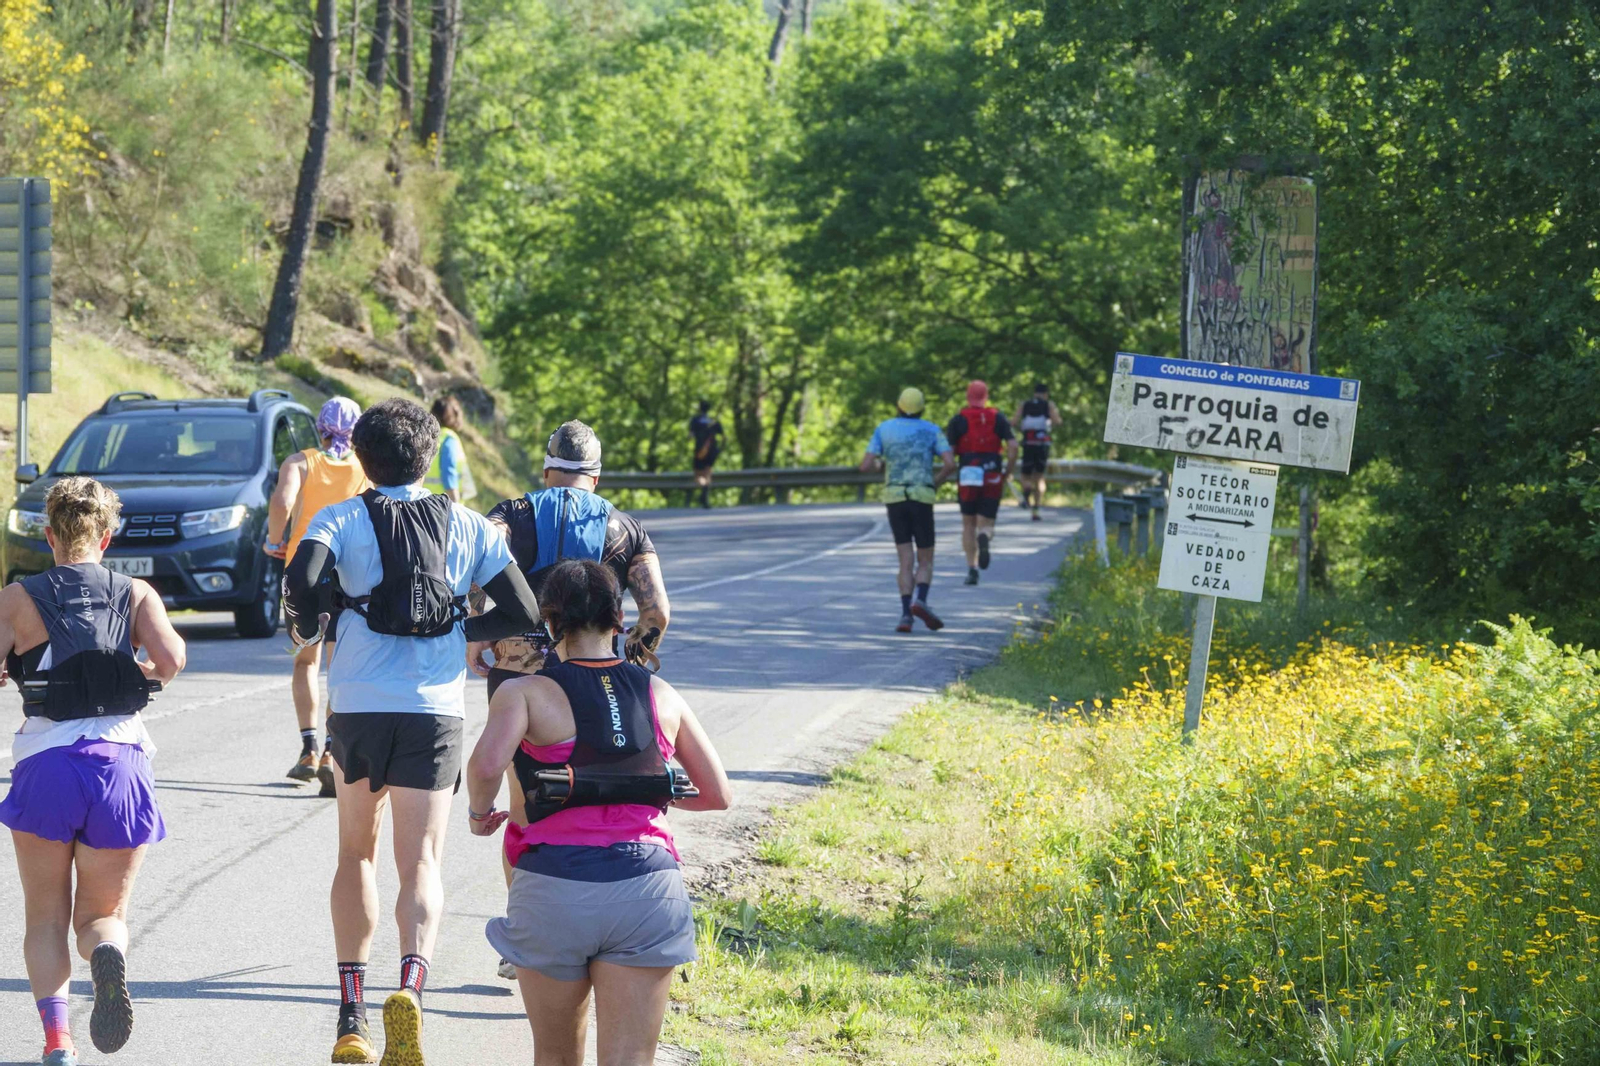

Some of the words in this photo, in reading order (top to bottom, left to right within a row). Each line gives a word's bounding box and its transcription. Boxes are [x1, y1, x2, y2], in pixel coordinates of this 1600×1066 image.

[1160, 364, 1218, 380] CONCELLO
[1220, 371, 1234, 382] de
[1237, 373, 1310, 391] PONTEAREAS
[1132, 382, 1278, 423] Parroquia
[1293, 404, 1330, 429] de
[1201, 474, 1250, 490] TECOR
[1177, 487, 1269, 508] SOCIETARIO
[1195, 504, 1255, 518] MONDARIZANA
[1186, 543, 1246, 561] VEDADO
[121, 560, 148, 574] KJY
[1204, 561, 1222, 574] DE
[1192, 575, 1230, 590] CAZA
[81, 586, 95, 621] EVADICT
[415, 583, 424, 621] KIPRUN
[601, 675, 622, 731] SALOMON
